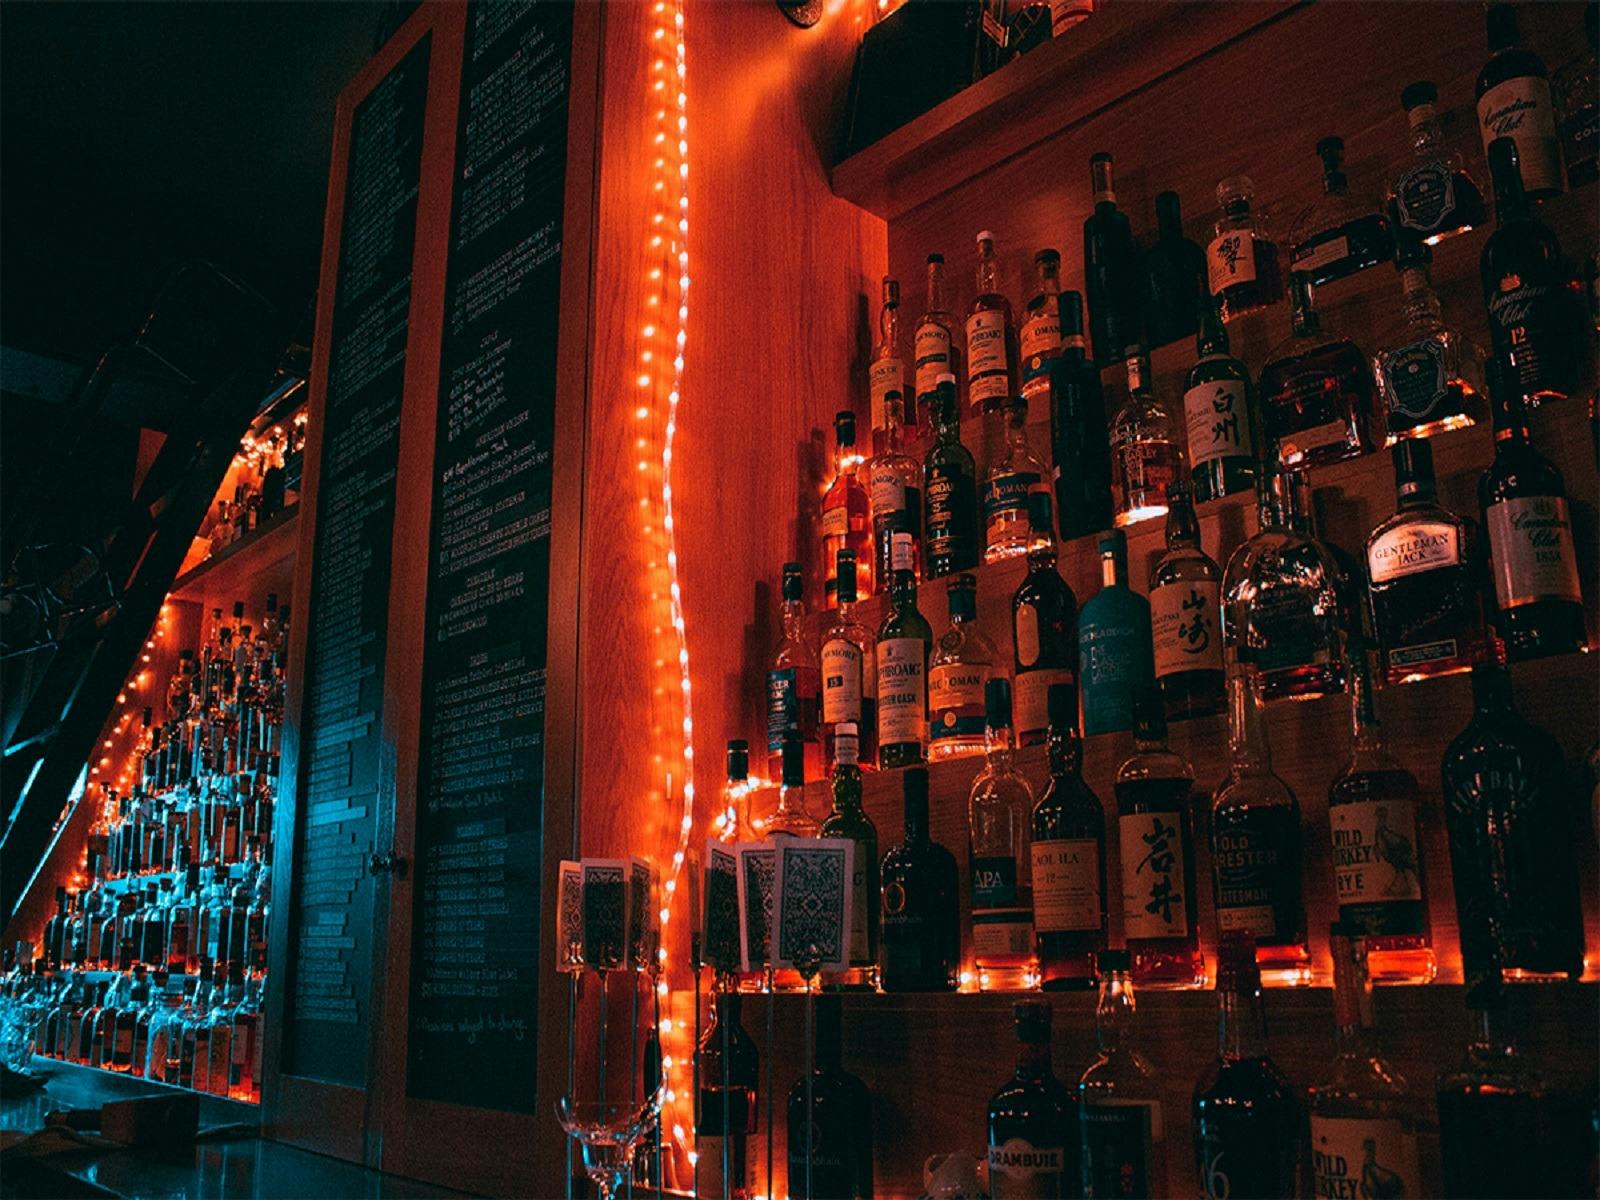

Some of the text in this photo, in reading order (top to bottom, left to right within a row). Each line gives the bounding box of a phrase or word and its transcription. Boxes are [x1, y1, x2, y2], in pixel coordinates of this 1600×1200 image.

[1510, 326, 1527, 345] 12
[1211, 387, 1239, 446] 白州
[1375, 534, 1448, 559] GENTLEMAN
[1399, 550, 1426, 565] JACK
